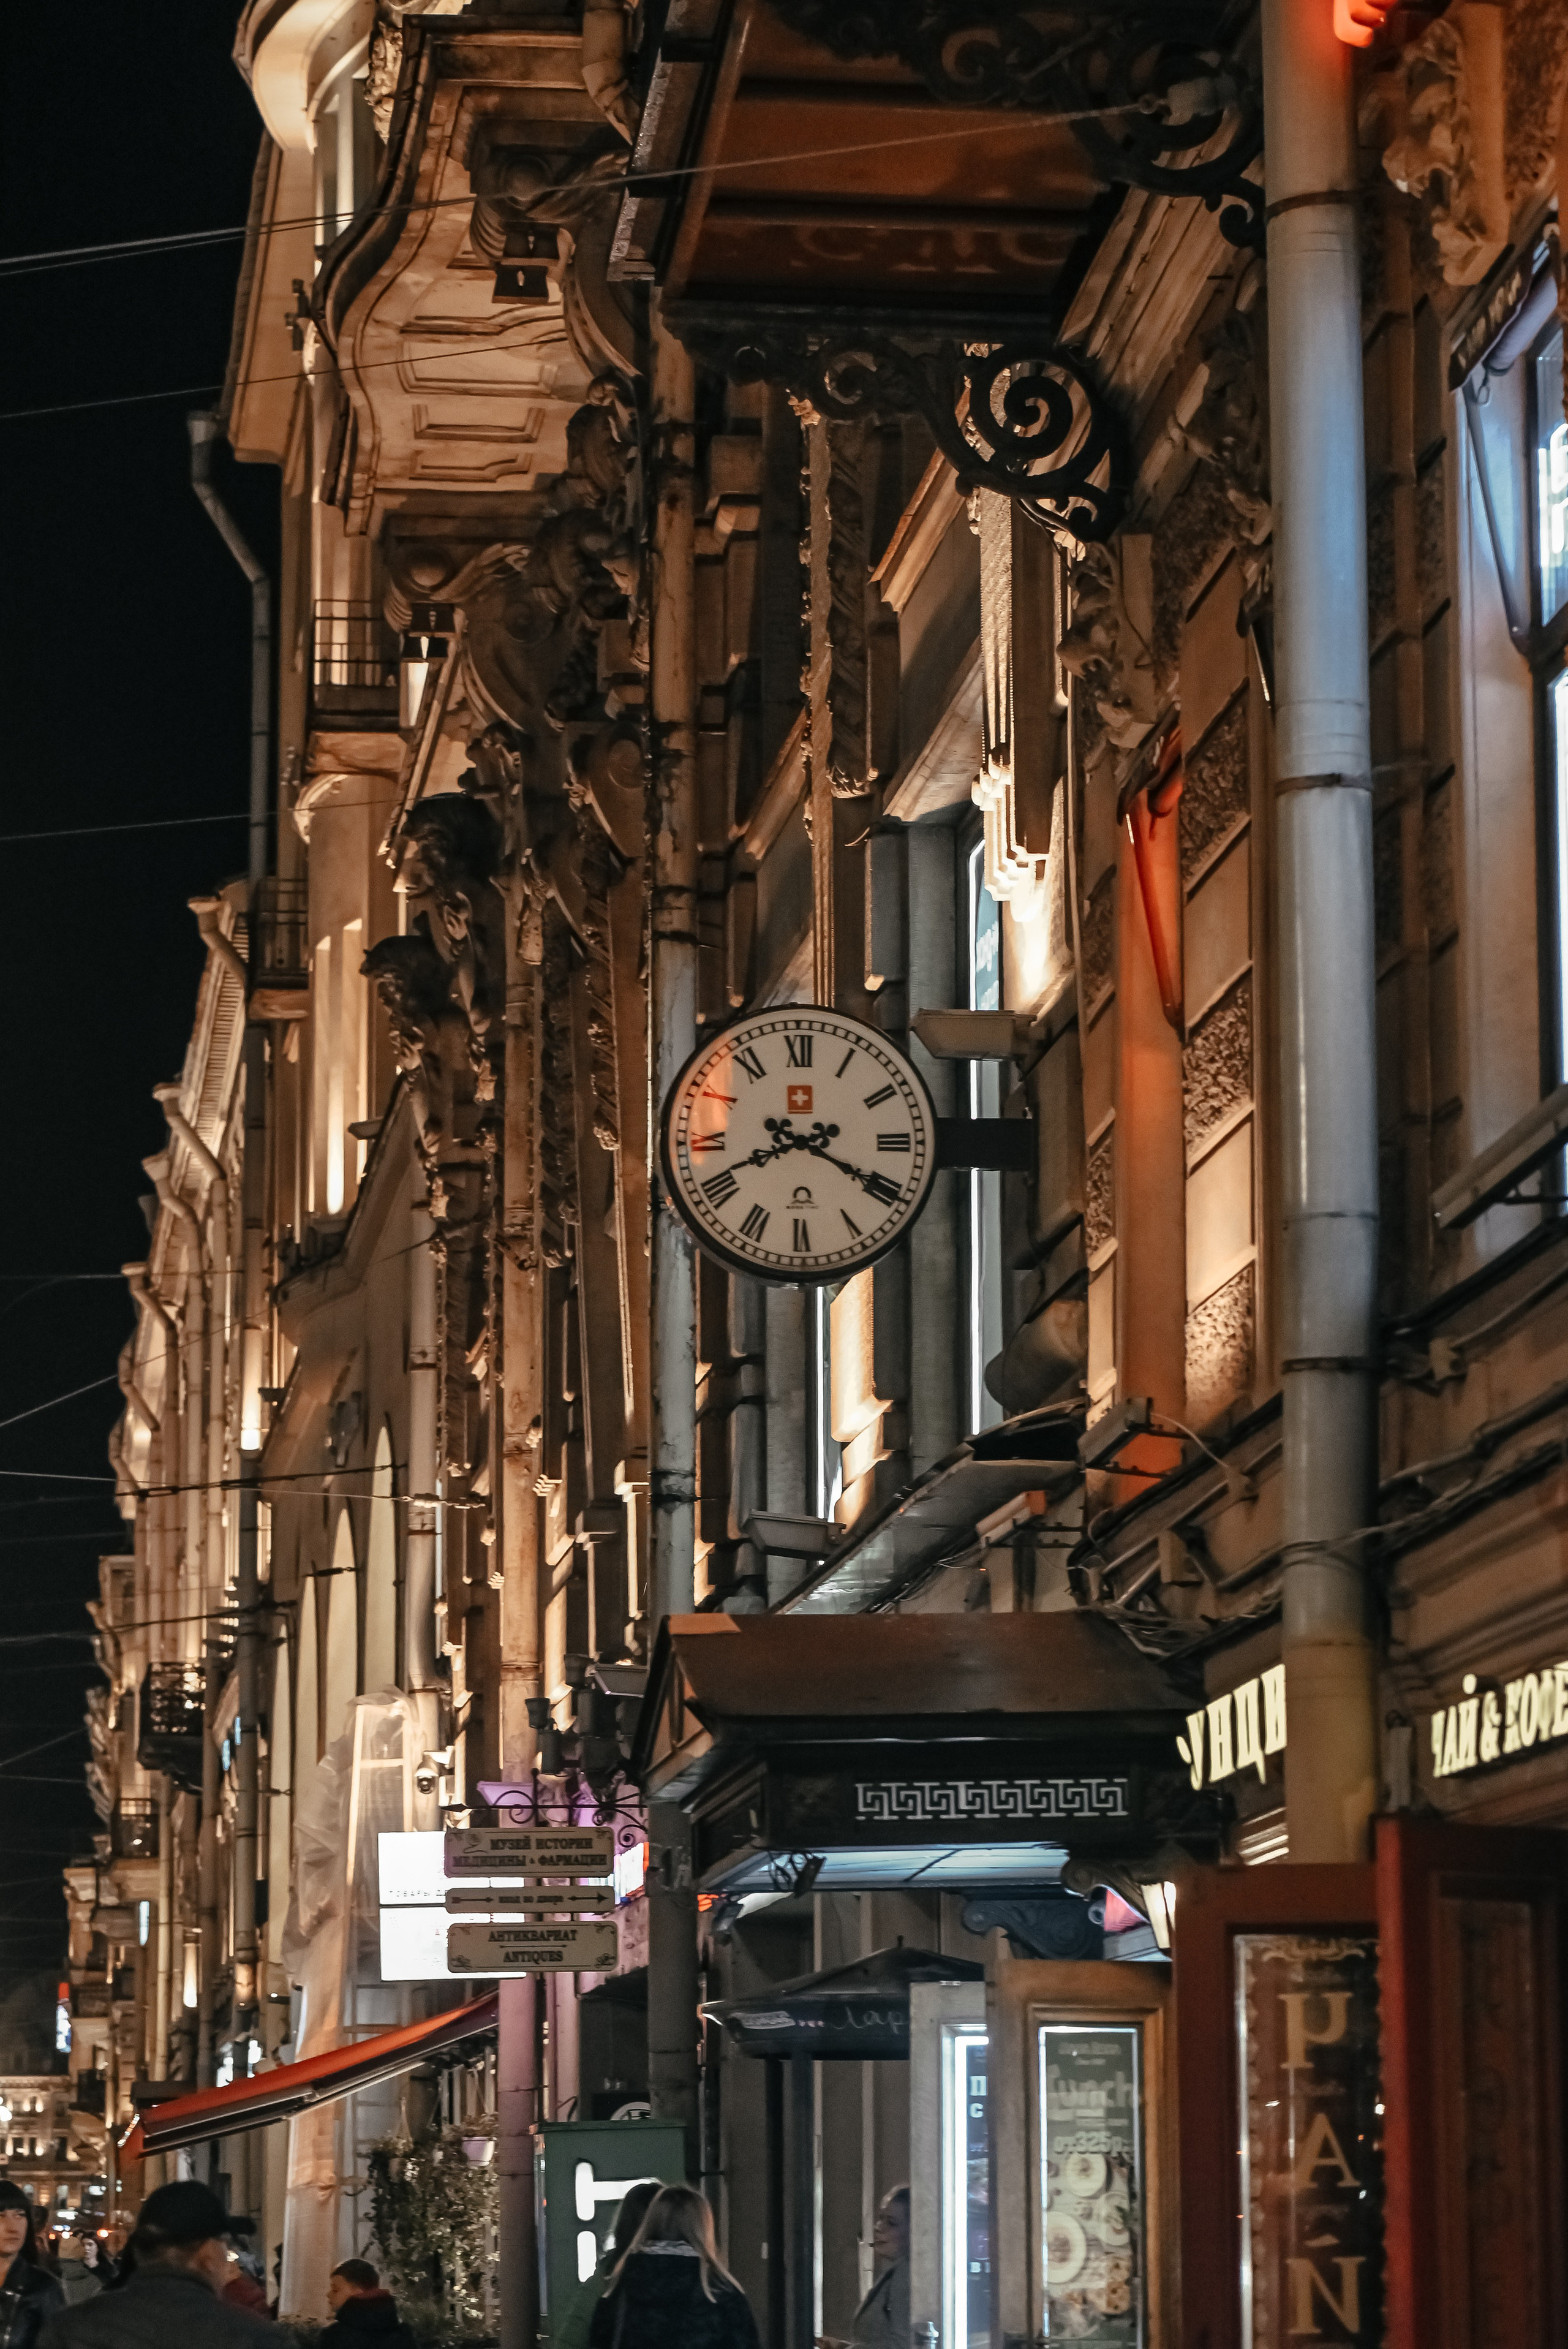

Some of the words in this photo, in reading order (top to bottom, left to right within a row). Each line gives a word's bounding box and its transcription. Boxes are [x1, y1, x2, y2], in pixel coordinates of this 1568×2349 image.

[732, 1046, 767, 1084] XI
[784, 1035, 813, 1067] XII
[835, 1048, 856, 1078] I
[703, 1083, 738, 1110] X
[864, 1083, 897, 1110] II
[690, 1131, 725, 1151] IX
[876, 1133, 911, 1152] III
[701, 1170, 741, 1210] VIII
[738, 1203, 771, 1243] VII
[793, 1218, 811, 1252] VI
[840, 1209, 862, 1239] V
[1431, 1673, 1479, 1777] ЧАЙ
[1480, 1691, 1502, 1763] &
[488, 1929, 577, 1942] АНТИКВАРИАТ
[503, 1950, 564, 1965] ANTIQUES
